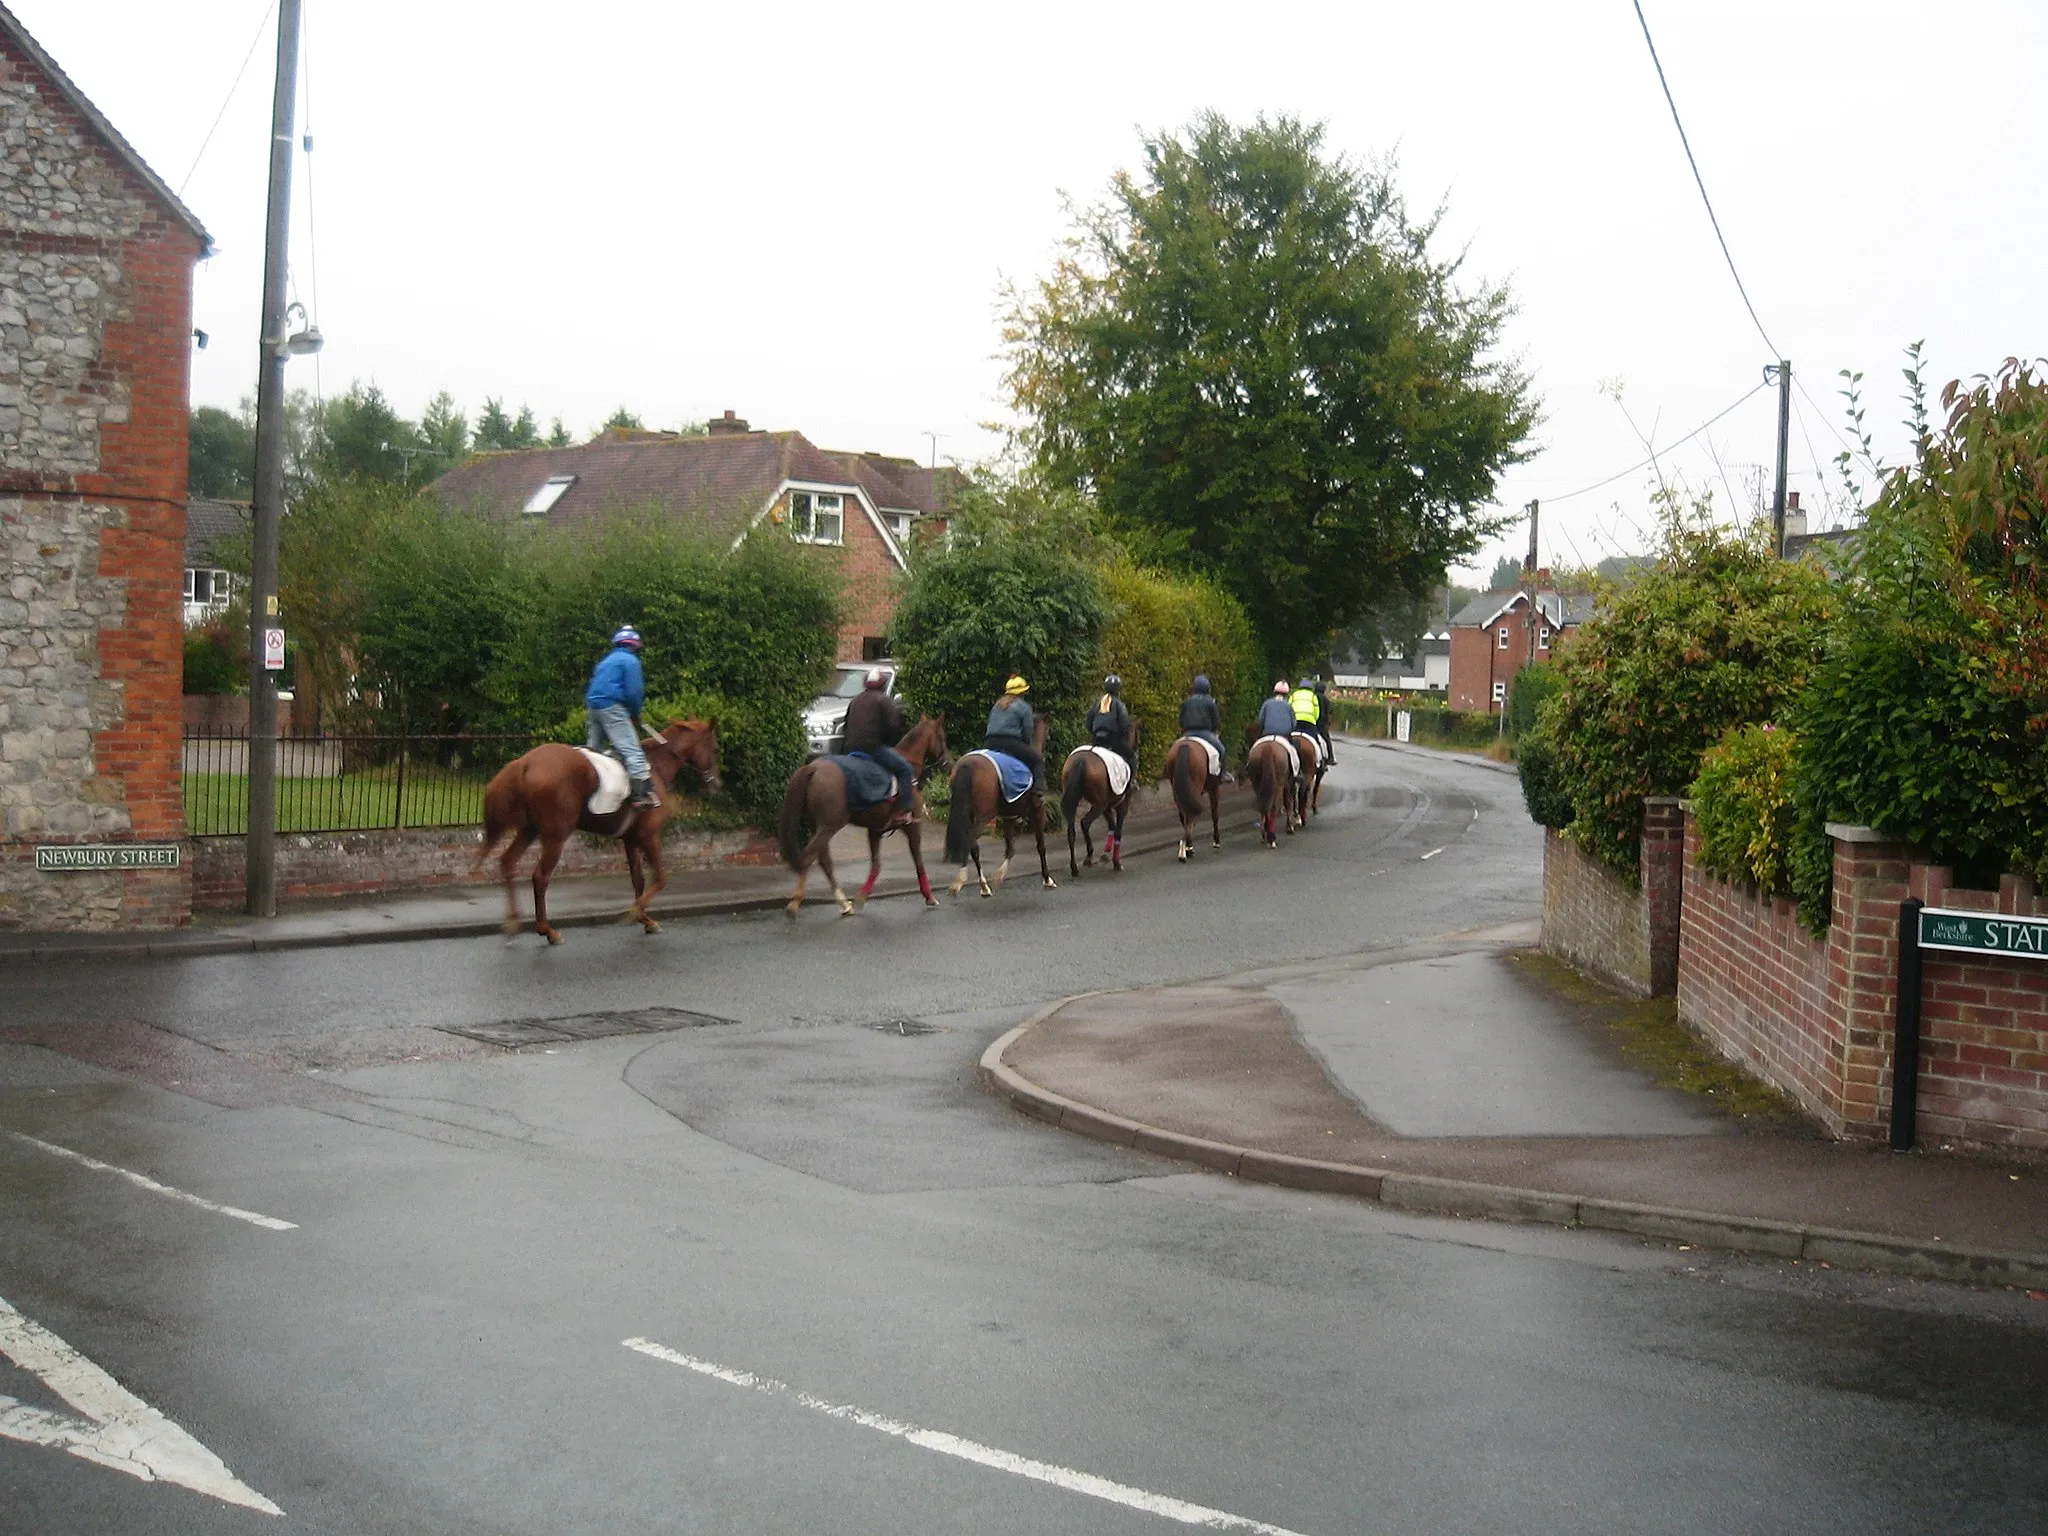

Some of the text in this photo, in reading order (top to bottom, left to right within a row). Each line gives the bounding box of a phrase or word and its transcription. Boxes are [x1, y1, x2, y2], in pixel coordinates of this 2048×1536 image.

[41, 849, 175, 865] NEWBURY STREET
[1936, 922, 1957, 932] West
[1932, 929, 1974, 941] Berkshire
